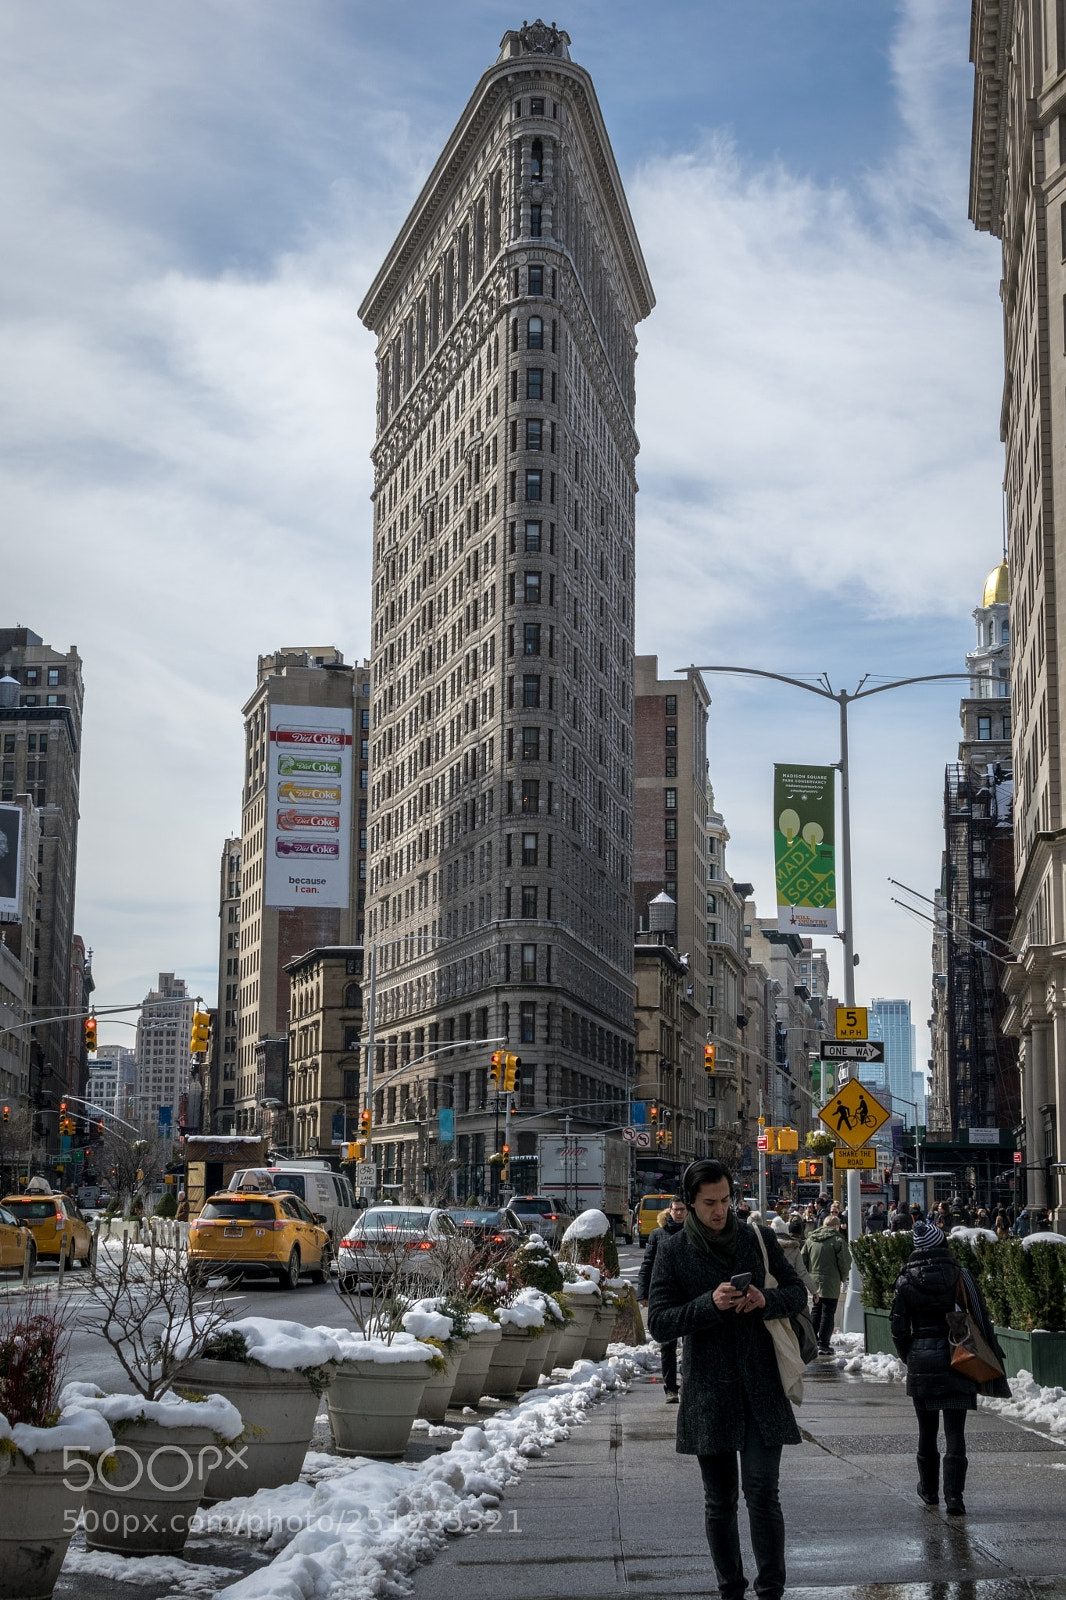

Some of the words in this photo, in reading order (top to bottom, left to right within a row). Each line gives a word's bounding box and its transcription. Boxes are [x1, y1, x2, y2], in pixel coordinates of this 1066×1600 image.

[292, 733, 312, 742] Diet
[313, 734, 340, 744] Coke
[312, 762, 337, 772] Coke
[312, 790, 336, 799] Coke
[310, 816, 335, 826] Coke
[310, 844, 335, 854] Coke
[776, 851, 810, 886] MAD.
[289, 876, 327, 885] because
[788, 878, 814, 900] SQ.
[813, 882, 836, 905] PK
[846, 1011, 857, 1027] 5
[830, 1047, 848, 1055] ONE
[856, 1048, 874, 1056] WAY
